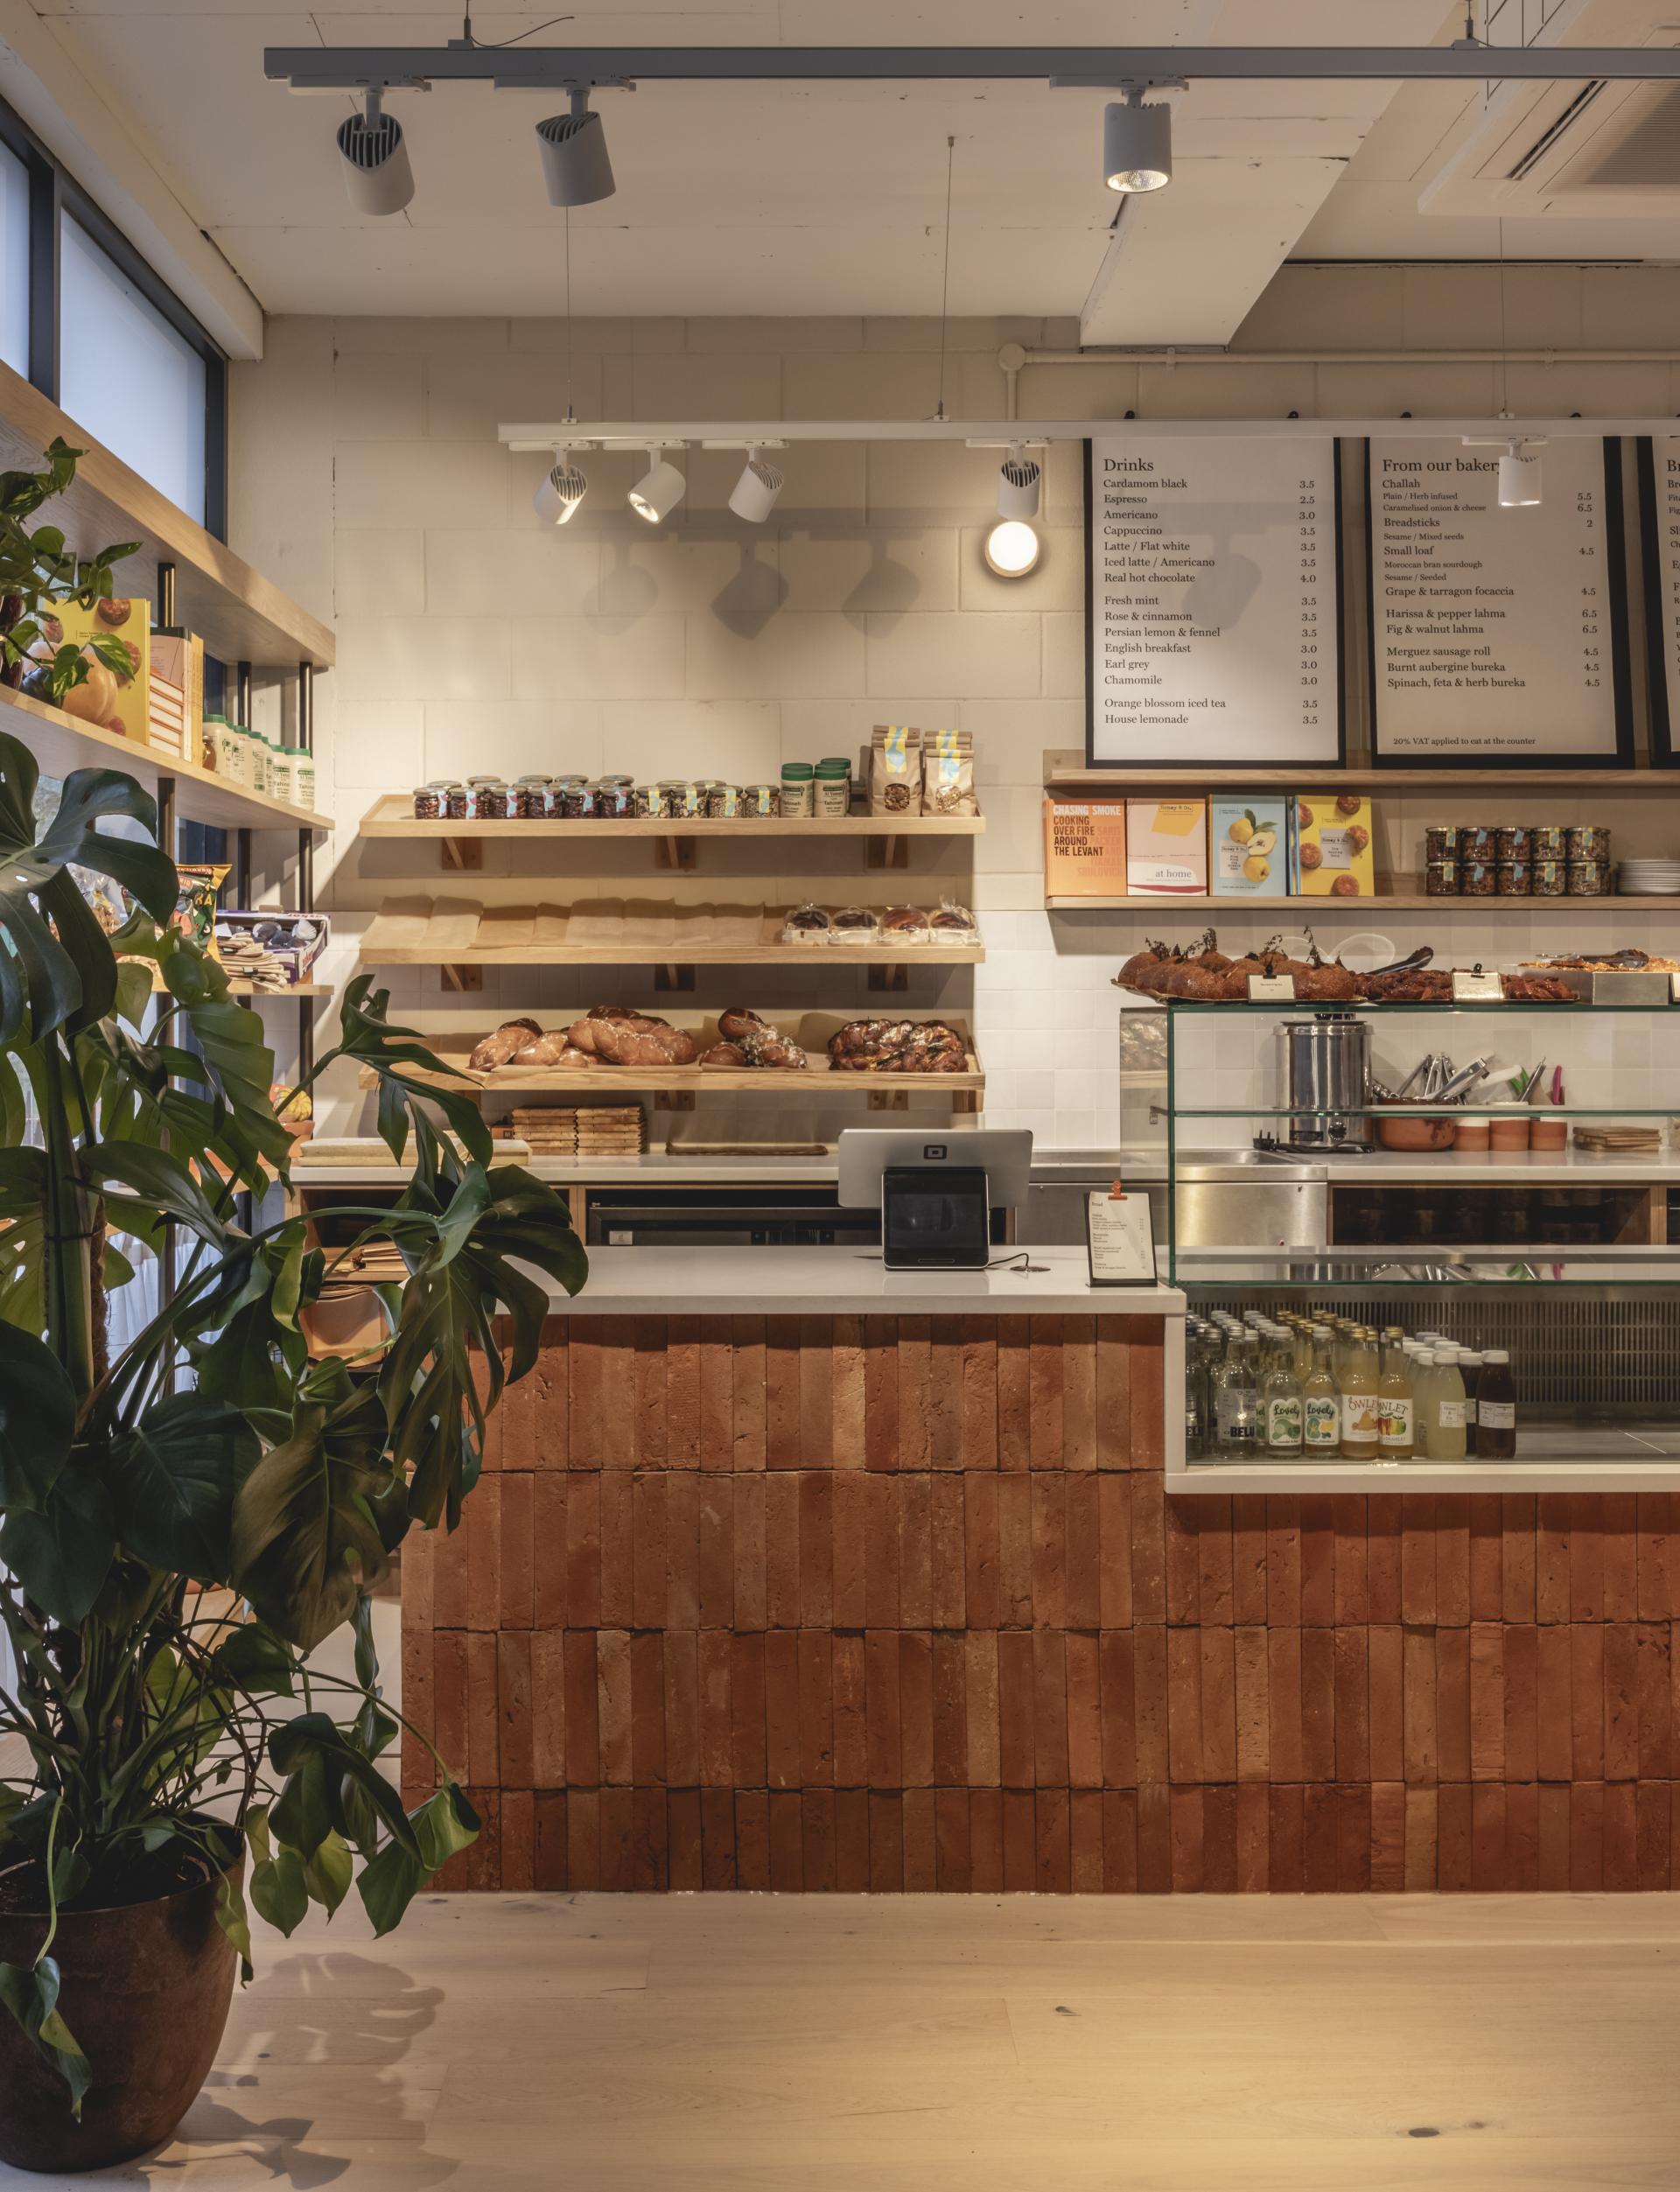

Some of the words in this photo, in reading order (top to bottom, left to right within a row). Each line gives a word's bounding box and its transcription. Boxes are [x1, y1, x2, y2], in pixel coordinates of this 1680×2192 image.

[1103, 458, 1154, 472] Drinks
[1382, 459, 1423, 473] From
[1426, 463, 1452, 472] our
[1103, 479, 1159, 488] Cardamom
[1160, 479, 1188, 488] black
[1298, 480, 1315, 489] 3.5
[1382, 480, 1421, 489] Challah
[1103, 494, 1148, 505] Espresso
[1299, 496, 1316, 505] 2.5
[1577, 493, 1592, 501] 5.5
[1577, 503, 1593, 513] 6.5
[1103, 510, 1158, 520] Americano
[1383, 518, 1441, 528] Breadsticks
[1103, 526, 1163, 537] Cappuccino
[1299, 528, 1316, 536] 3.5
[1104, 542, 1130, 551] Latte
[1140, 542, 1160, 551] Flat
[1162, 542, 1191, 551] white
[1299, 543, 1316, 552] 3.5
[1383, 546, 1413, 556] Small
[1414, 546, 1435, 556] loaf
[1104, 557, 1126, 567] Iced
[1128, 557, 1152, 567] latte
[1159, 557, 1215, 567] Americano
[1300, 559, 1317, 568] 3.5
[1442, 561, 1483, 571] sourdough
[1104, 573, 1127, 583] Real
[1129, 573, 1147, 583] hot
[1147, 573, 1196, 583] chocolate
[1299, 575, 1317, 584] 4.0
[1419, 573, 1447, 582] Seeded
[1385, 587, 1417, 599] Grape
[1418, 587, 1428, 596] &
[1429, 588, 1473, 599] tarragon
[1474, 586, 1515, 596] focaccia
[1104, 596, 1132, 606] Fresh
[1135, 596, 1159, 606] mint
[1301, 598, 1317, 606] 3.5
[1104, 612, 1130, 621] Rose
[1130, 612, 1140, 621] &
[1142, 612, 1193, 621] cinnamon
[1301, 613, 1317, 622] 3.5
[1385, 609, 1424, 619] Harissa
[1425, 609, 1435, 619] &
[1437, 612, 1473, 621] pepper
[1474, 609, 1506, 619] lahma
[1581, 609, 1598, 619] 6.5
[1105, 627, 1142, 637] Persian
[1144, 627, 1176, 637] lemon
[1178, 627, 1187, 637] &
[1189, 627, 1221, 637] fennel
[1301, 629, 1317, 638] 3.5
[1386, 625, 1404, 636] Fig
[1404, 625, 1414, 634] &
[1415, 624, 1451, 634] walnut
[1452, 624, 1485, 634] lahma
[1582, 625, 1598, 634] 6.5
[1105, 643, 1143, 655] English
[1144, 643, 1192, 653] breakfast
[1300, 645, 1318, 654] 3.0
[1386, 648, 1432, 659] Merguez
[1432, 649, 1472, 659] sausage
[1473, 647, 1491, 656] roll
[1583, 648, 1600, 656] 4.5
[1105, 660, 1126, 669] Earl
[1127, 662, 1150, 671] grey
[1300, 661, 1318, 669] 3.0
[1387, 663, 1417, 672] Burnt
[1418, 662, 1469, 674] aubergine
[1470, 662, 1506, 673] bureka
[1583, 663, 1600, 672] 4.5
[1104, 675, 1163, 685] Chamomile
[1301, 677, 1318, 686] 3.0
[1387, 678, 1432, 690] Spinach,
[1432, 677, 1453, 687] feta
[1454, 678, 1464, 687] &
[1465, 677, 1489, 687] herb
[1490, 677, 1526, 687] bureka
[1584, 679, 1600, 688] 4.5
[1104, 699, 1142, 710] Orange
[1144, 698, 1186, 708] blossom
[1187, 698, 1208, 708] iced
[1302, 700, 1318, 709] 3.5
[1105, 715, 1138, 724] House
[1139, 714, 1189, 724] lemonade
[1302, 716, 1319, 725] 3.5
[1431, 737, 1460, 747] applied
[1053, 805, 1089, 816] CHASING
[1092, 805, 1121, 816] SMOKE
[1054, 816, 1089, 825] COOKING
[1054, 826, 1075, 836] OVER
[1077, 826, 1096, 836] FIRE
[1054, 836, 1088, 846] AROUND
[1054, 846, 1070, 856] THE
[1072, 846, 1104, 857] LEVANT
[1166, 868, 1192, 878] home
[1273, 1404, 1300, 1417] Lovely
[1307, 1404, 1334, 1417] Lovely
[1229, 1425, 1255, 1437] BELU
